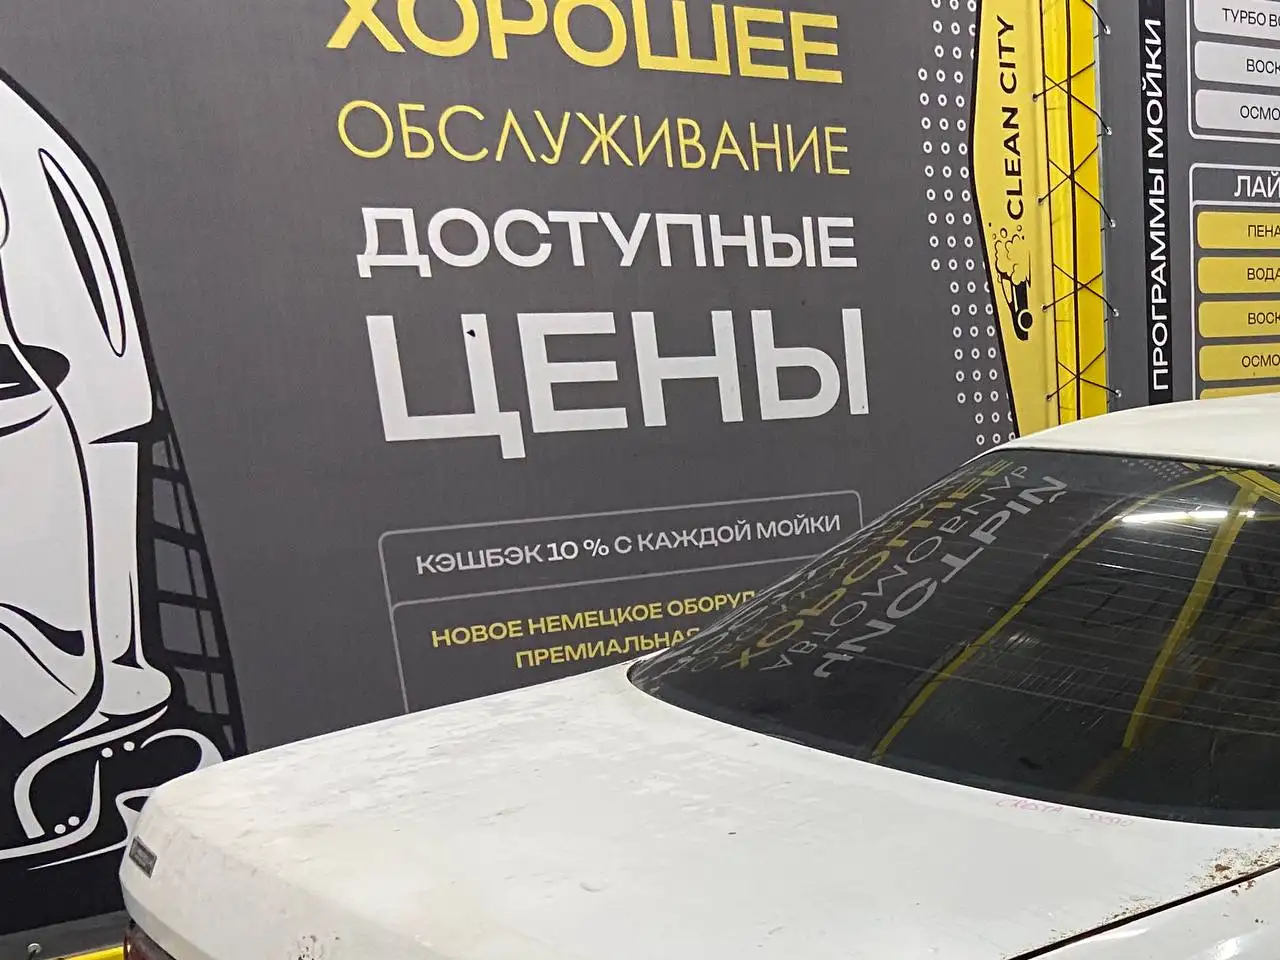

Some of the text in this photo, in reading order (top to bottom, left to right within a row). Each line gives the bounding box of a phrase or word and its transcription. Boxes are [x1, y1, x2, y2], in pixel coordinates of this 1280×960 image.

[326, 0, 843, 84] ХОРОШЕЕ
[1222, 8, 1267, 26] ТУРБО
[338, 100, 850, 175] ОБСЛУЖИВАНИЕ
[997, 15, 1025, 220] CLEAN CITY
[1142, 18, 1169, 391] ПРОГРАММЫ МОЙКИ
[357, 207, 858, 278] ДОСТУПНЫЕ
[366, 308, 869, 459] ЦЕНЫ
[416, 514, 841, 575] КЭШБЭК 10 % С КАЖДОЙ МОЙКИ
[431, 620, 524, 648] НОВОЕ
[528, 603, 663, 635] НЕМЕЦКОЕ
